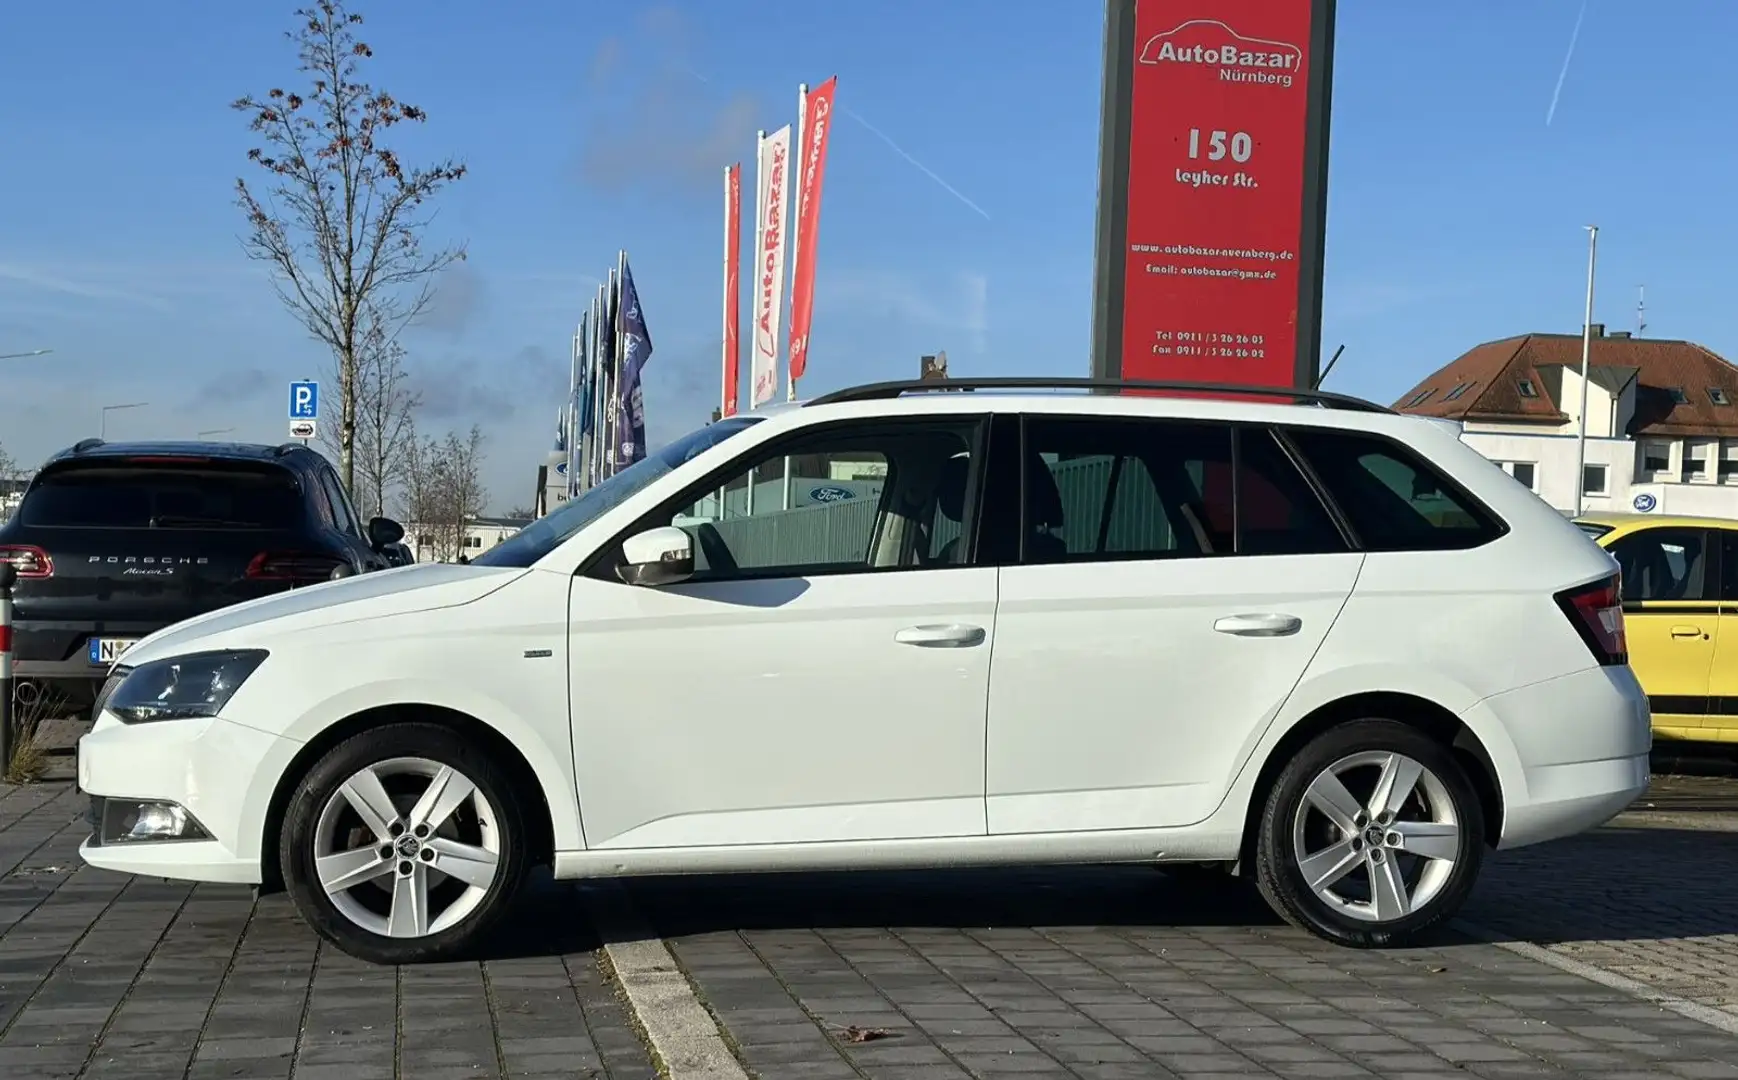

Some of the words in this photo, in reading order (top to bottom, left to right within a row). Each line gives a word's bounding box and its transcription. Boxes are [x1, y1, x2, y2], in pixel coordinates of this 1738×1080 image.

[1157, 42, 1295, 69] AutoBazar
[1220, 68, 1292, 87] Nürnberg
[1188, 128, 1252, 162] 150
[1176, 168, 1228, 187] Leyher
[1232, 172, 1258, 188] Str.
[1131, 244, 1294, 261] www.autobazar-nuernberg.de
[1146, 263, 1178, 274] Email:
[1180, 267, 1277, 280] autobazar@gmx.de
[1156, 331, 1172, 340] Tel
[1177, 331, 1202, 342] 0911
[1220, 333, 1233, 343] 26
[1236, 334, 1248, 344] 26
[1220, 346, 1233, 357] 26
[1236, 347, 1248, 358] 26
[1251, 347, 1265, 358] 02
[296, 386, 312, 414] P
[817, 488, 847, 501] Ford
[89, 556, 208, 564] PORSCHE
[123, 567, 160, 575] Macan
